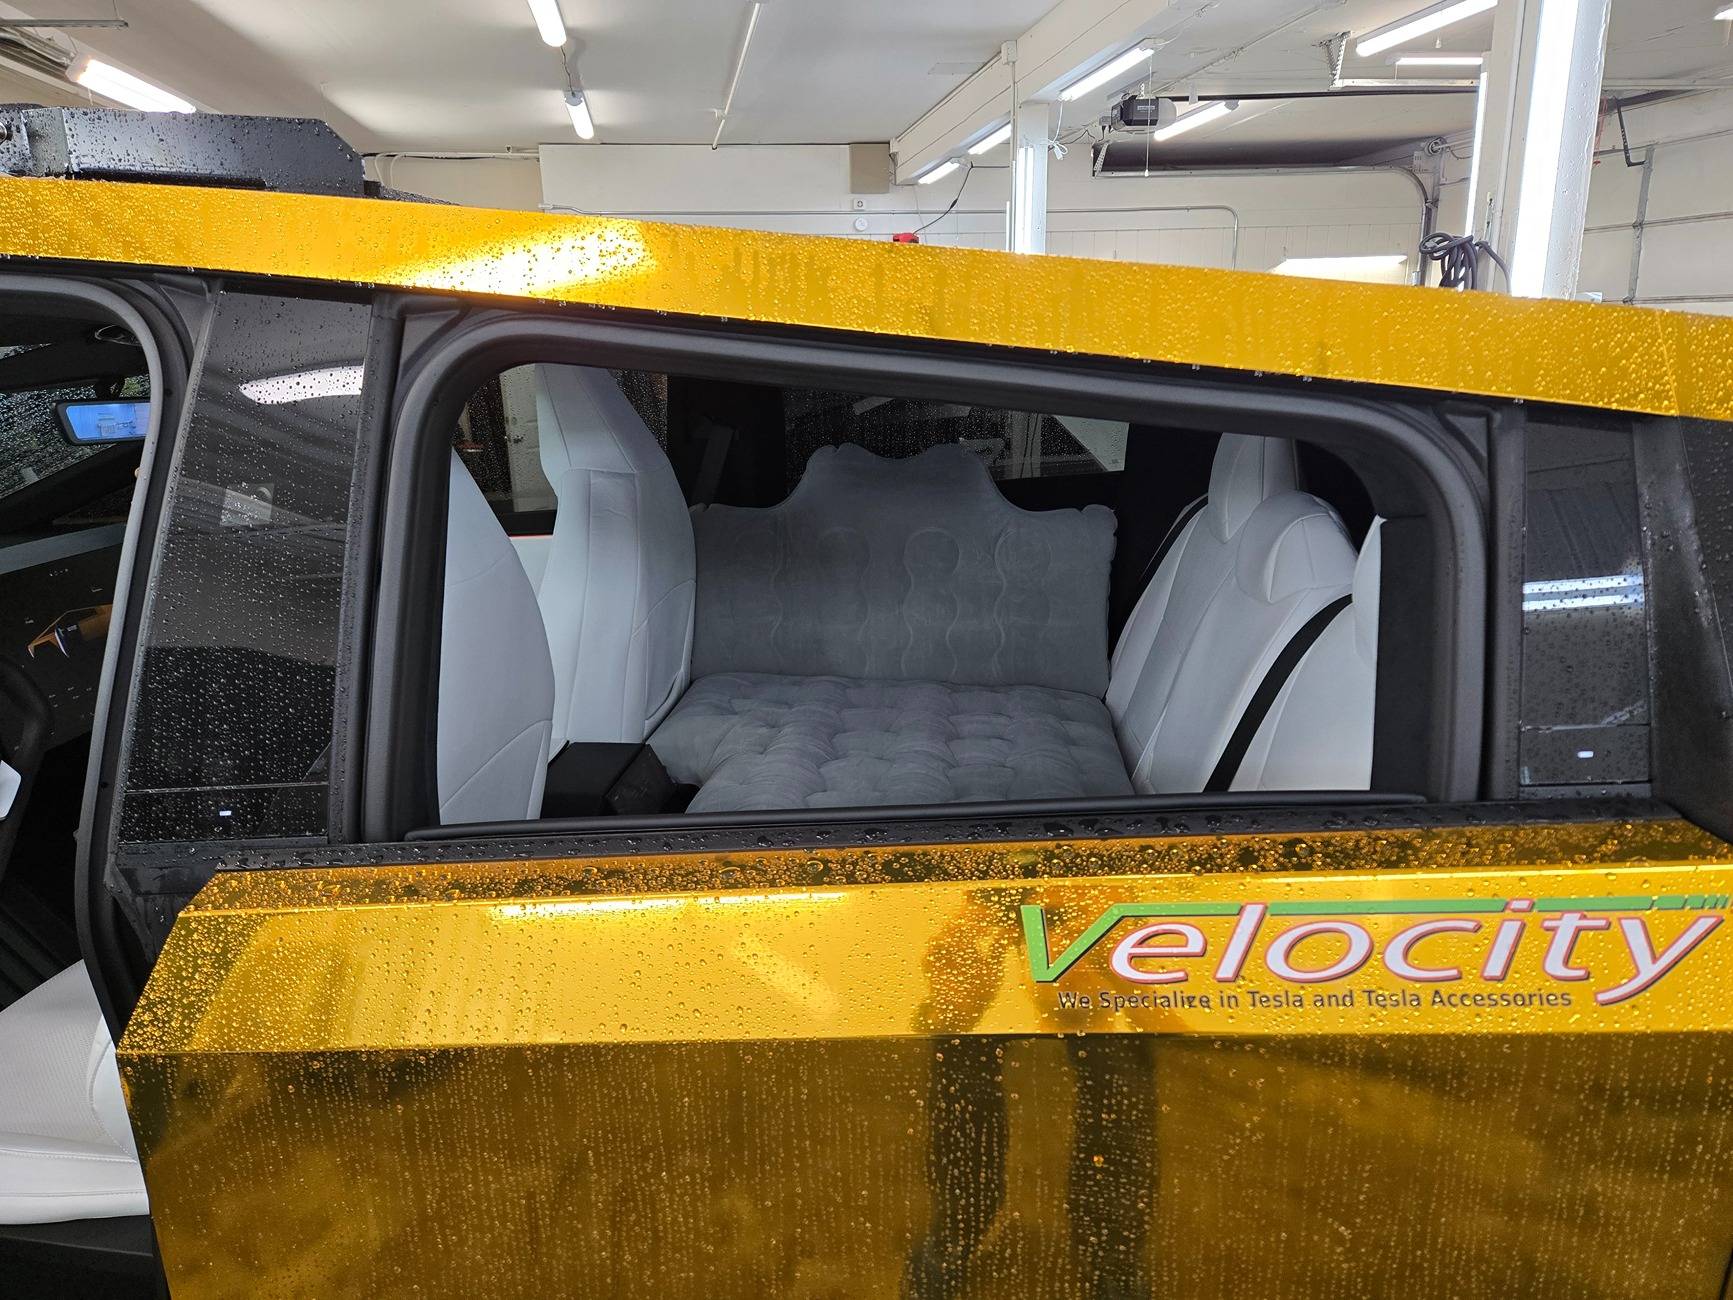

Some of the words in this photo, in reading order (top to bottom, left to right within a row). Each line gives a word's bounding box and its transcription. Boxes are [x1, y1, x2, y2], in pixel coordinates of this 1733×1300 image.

[1020, 896, 1728, 1006] Velocity
[1058, 991, 1091, 1009] We
[1099, 991, 1210, 1013] Specialize
[1219, 991, 1239, 1008] in
[1247, 990, 1304, 1008] Tesla
[1312, 990, 1354, 1007] and
[1362, 989, 1422, 1007] Tesla
[1430, 989, 1573, 1007] Accessories
